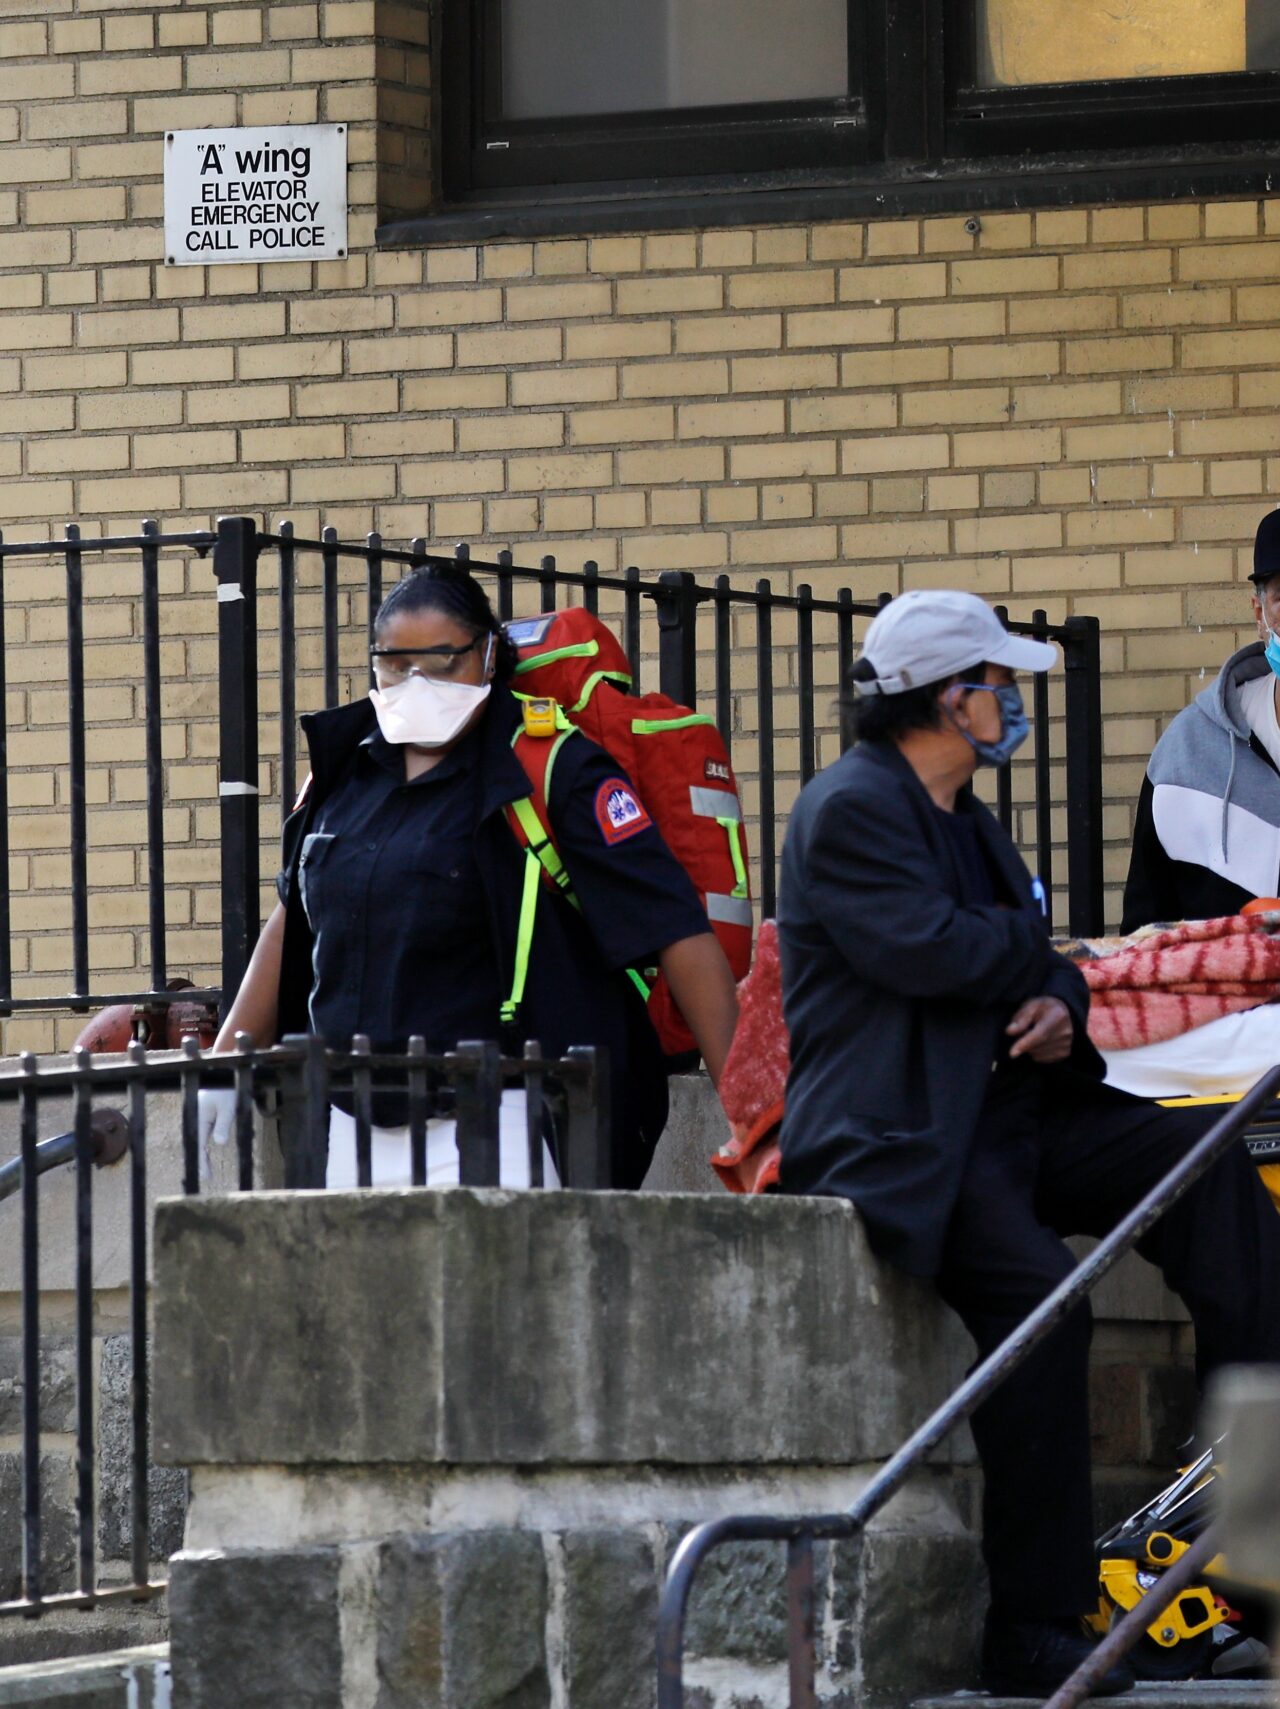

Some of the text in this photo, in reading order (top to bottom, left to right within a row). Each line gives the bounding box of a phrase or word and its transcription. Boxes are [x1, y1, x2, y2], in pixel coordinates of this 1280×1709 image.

[235, 142, 311, 178] wing
[201, 179, 307, 203] ELEVATOR
[191, 202, 320, 226] EMERGENCY
[185, 226, 325, 252] CALL POLICE
